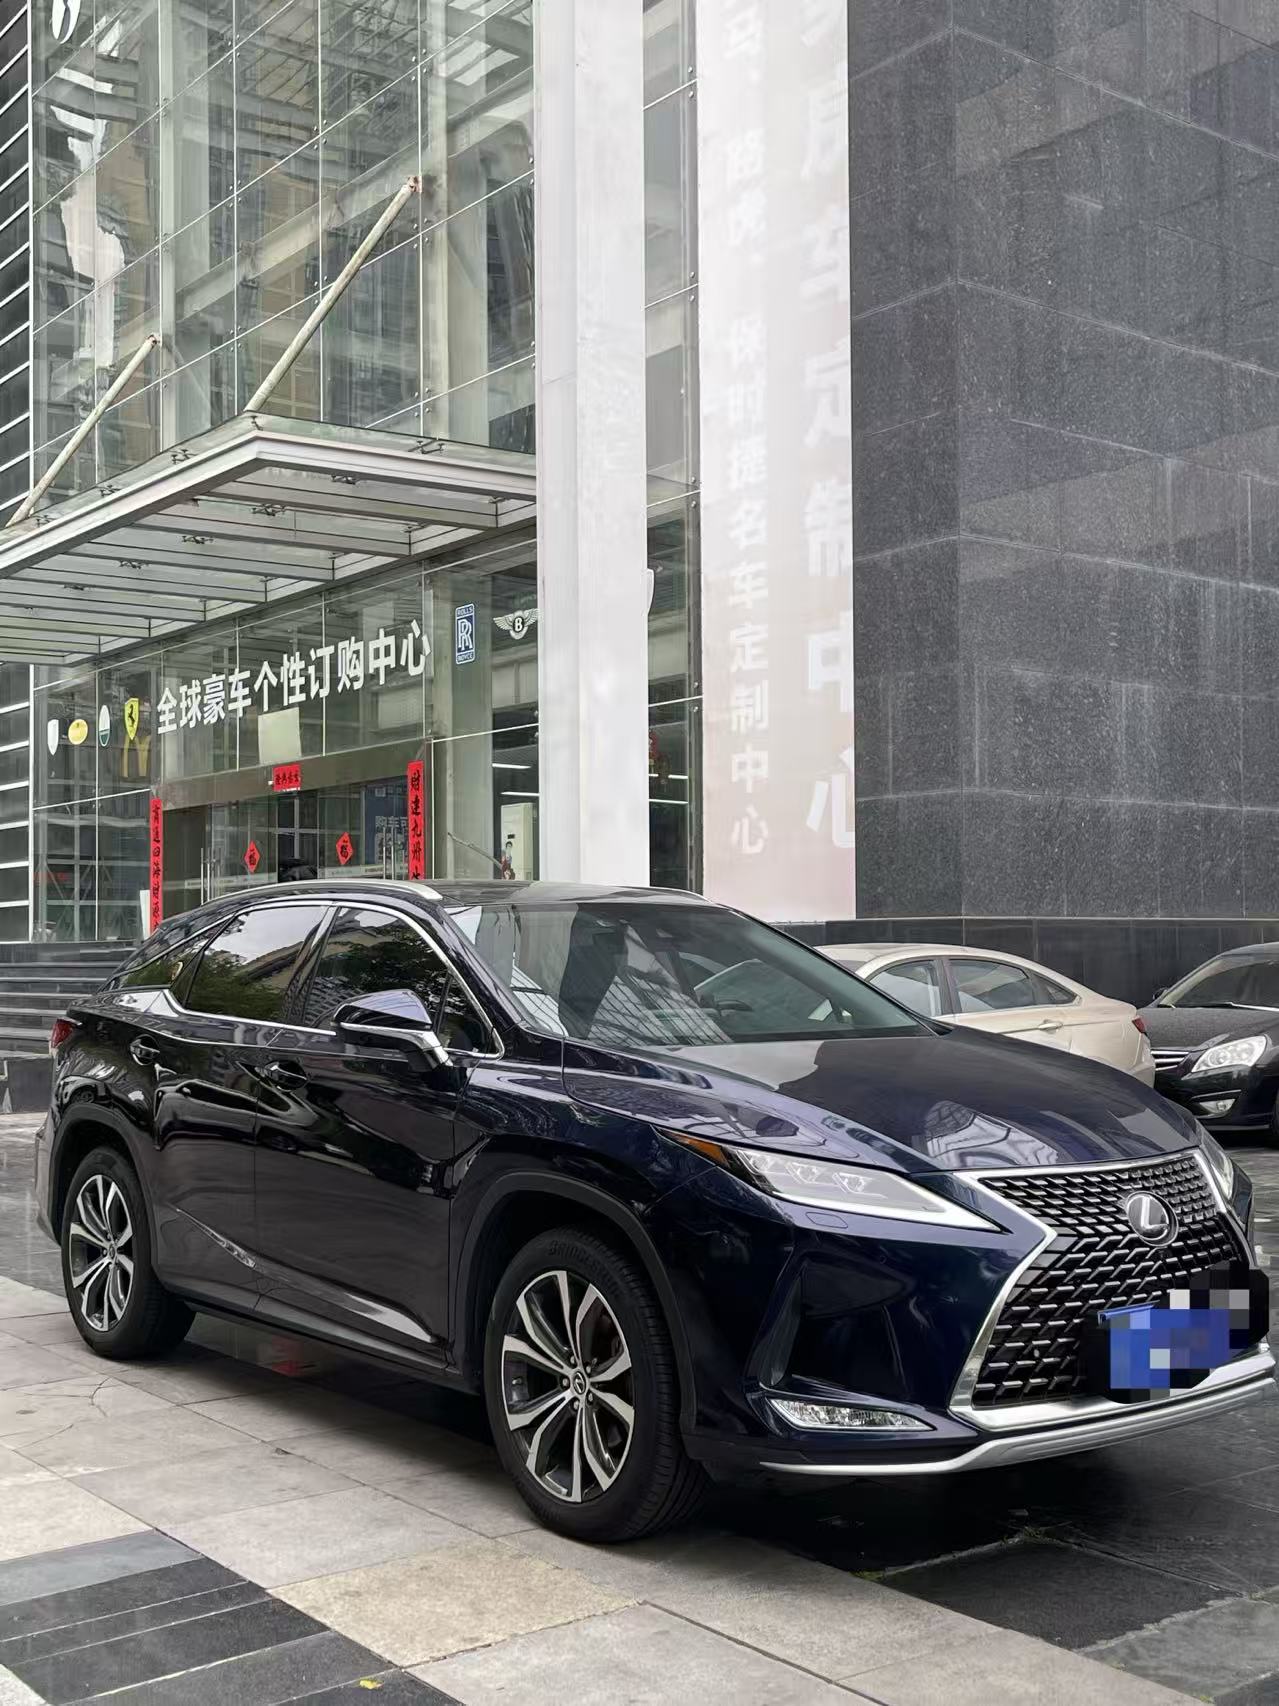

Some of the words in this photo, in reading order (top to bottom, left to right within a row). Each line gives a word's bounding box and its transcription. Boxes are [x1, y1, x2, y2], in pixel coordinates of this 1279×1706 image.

[157, 619, 431, 735] 全球豪车个性订购中心
